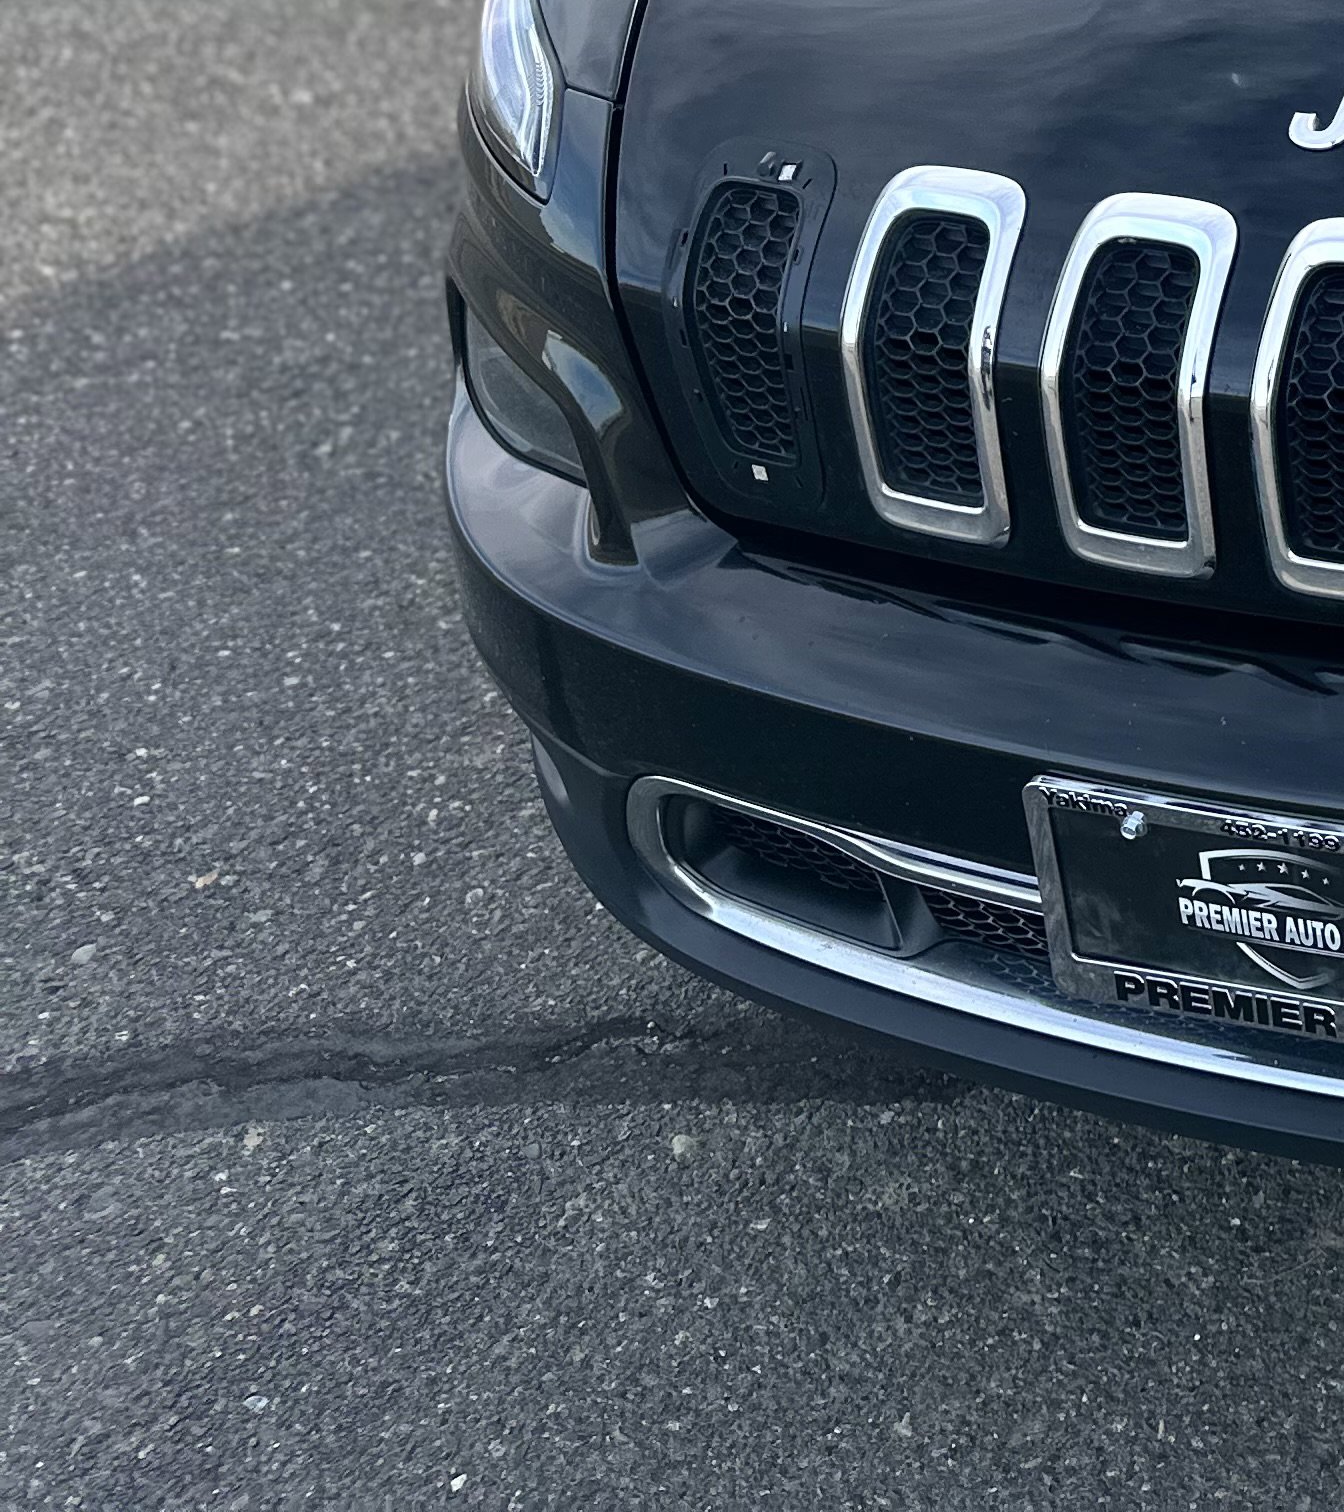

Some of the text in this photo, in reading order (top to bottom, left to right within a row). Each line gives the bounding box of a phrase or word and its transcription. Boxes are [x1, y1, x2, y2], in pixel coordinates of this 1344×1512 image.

[1039, 786, 1128, 817] Yakima
[1178, 897, 1280, 941] PREMIER
[1285, 916, 1341, 951] AUTO
[1114, 971, 1338, 1037] PREMIER
